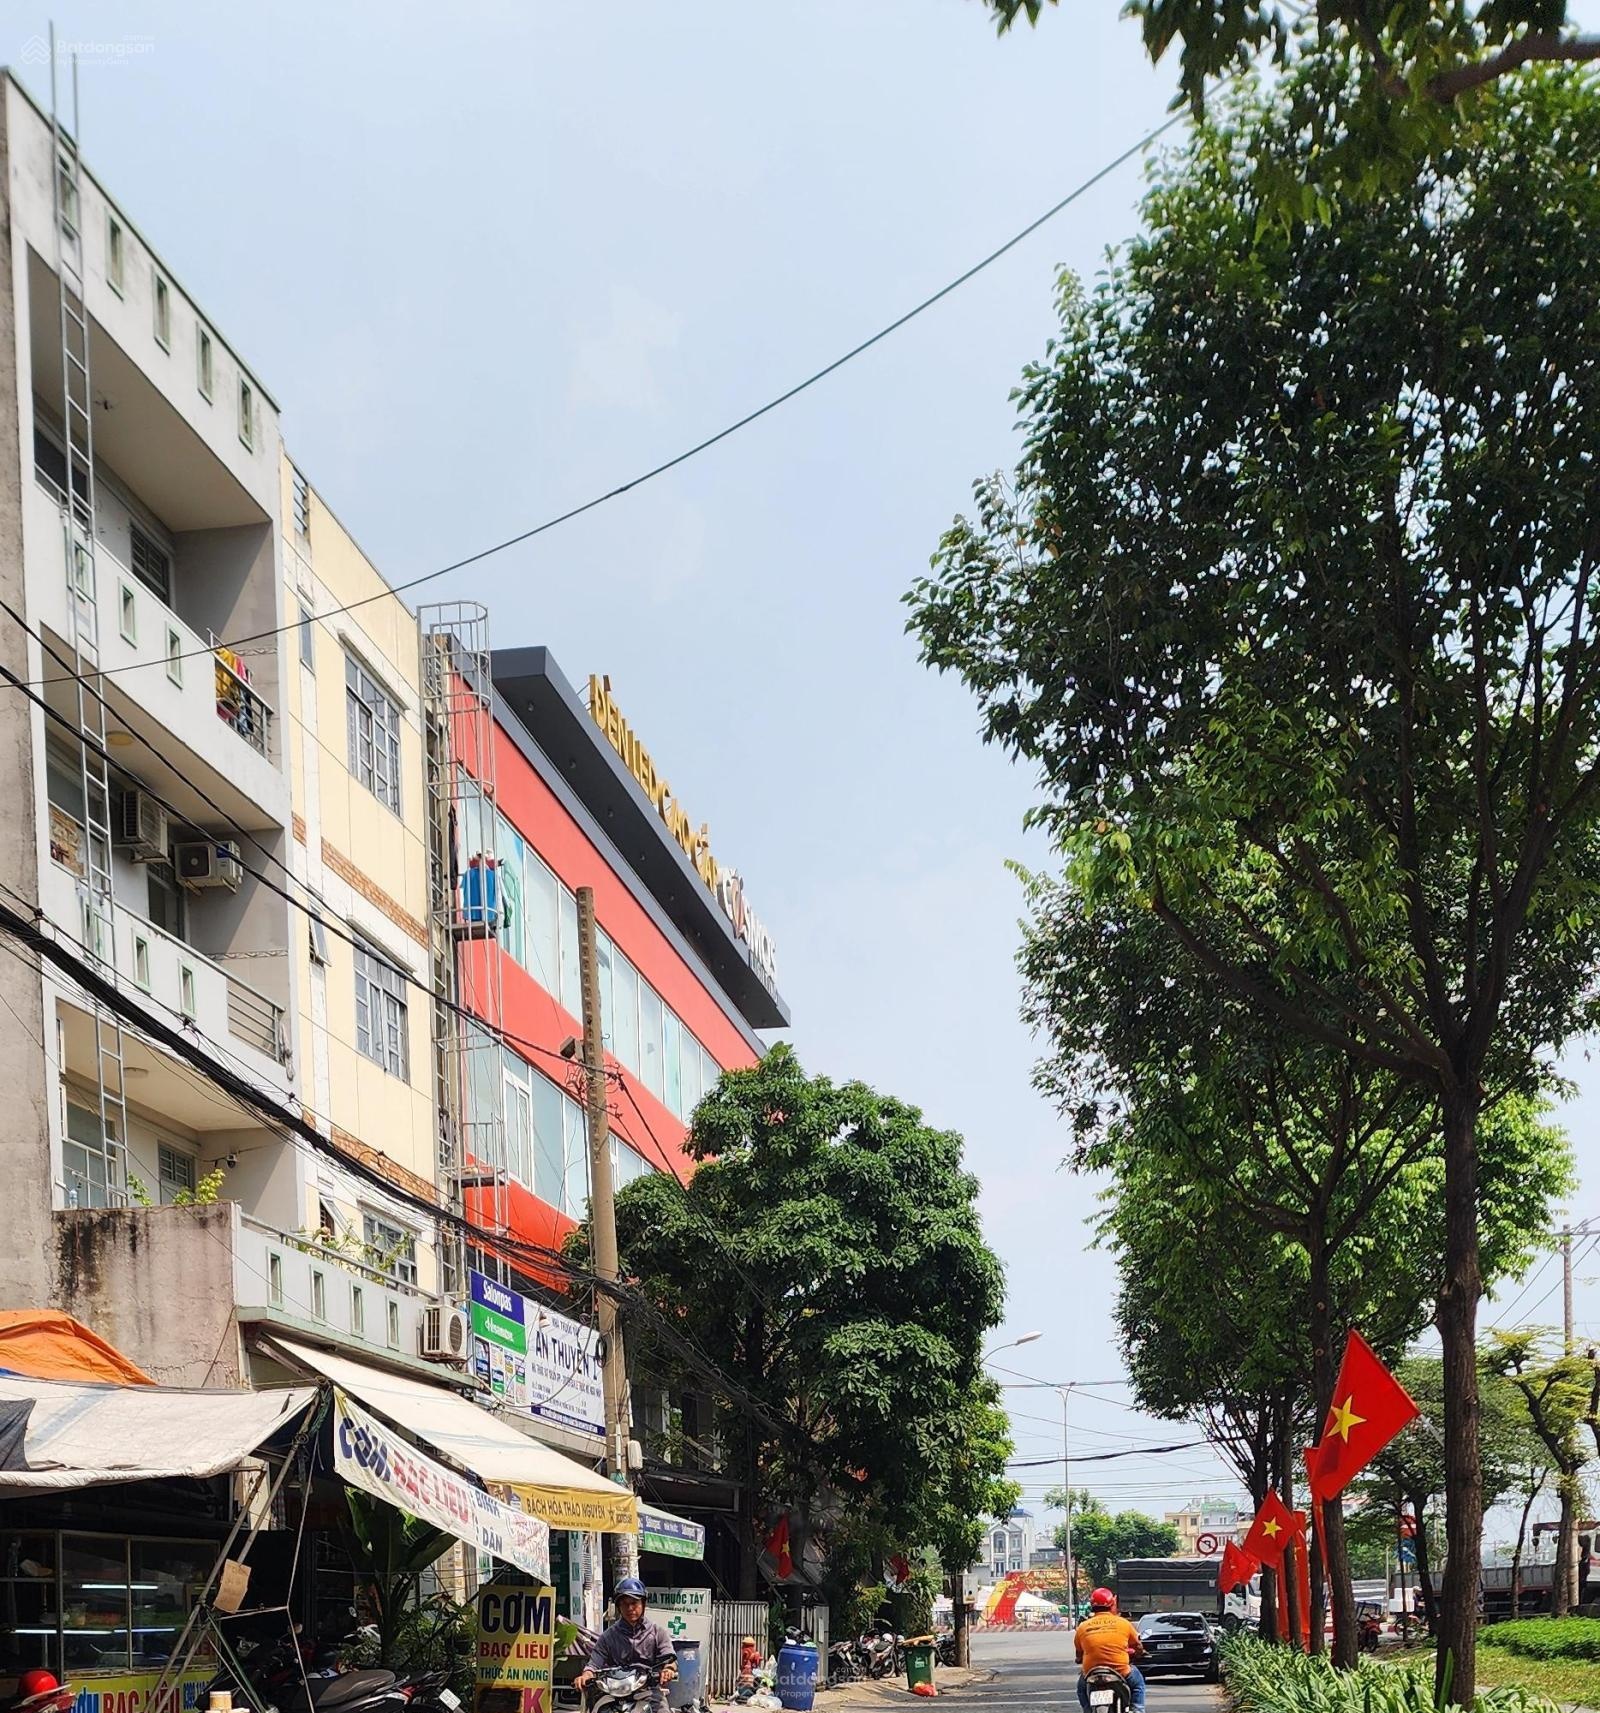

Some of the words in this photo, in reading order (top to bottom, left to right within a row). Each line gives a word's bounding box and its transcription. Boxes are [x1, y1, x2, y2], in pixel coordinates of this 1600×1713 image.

[527, 1494, 546, 1514] BÁCH
[482, 1525, 503, 1554] DÂN
[660, 1589, 687, 1604] THUỐC
[690, 1591, 705, 1605] TÂY
[482, 1591, 551, 1634] CƠM
[480, 1641, 511, 1661] BẠC
[516, 1640, 549, 1659] LIÊU
[480, 1664, 504, 1680] THỨC
[522, 1666, 549, 1682] NÓNG
